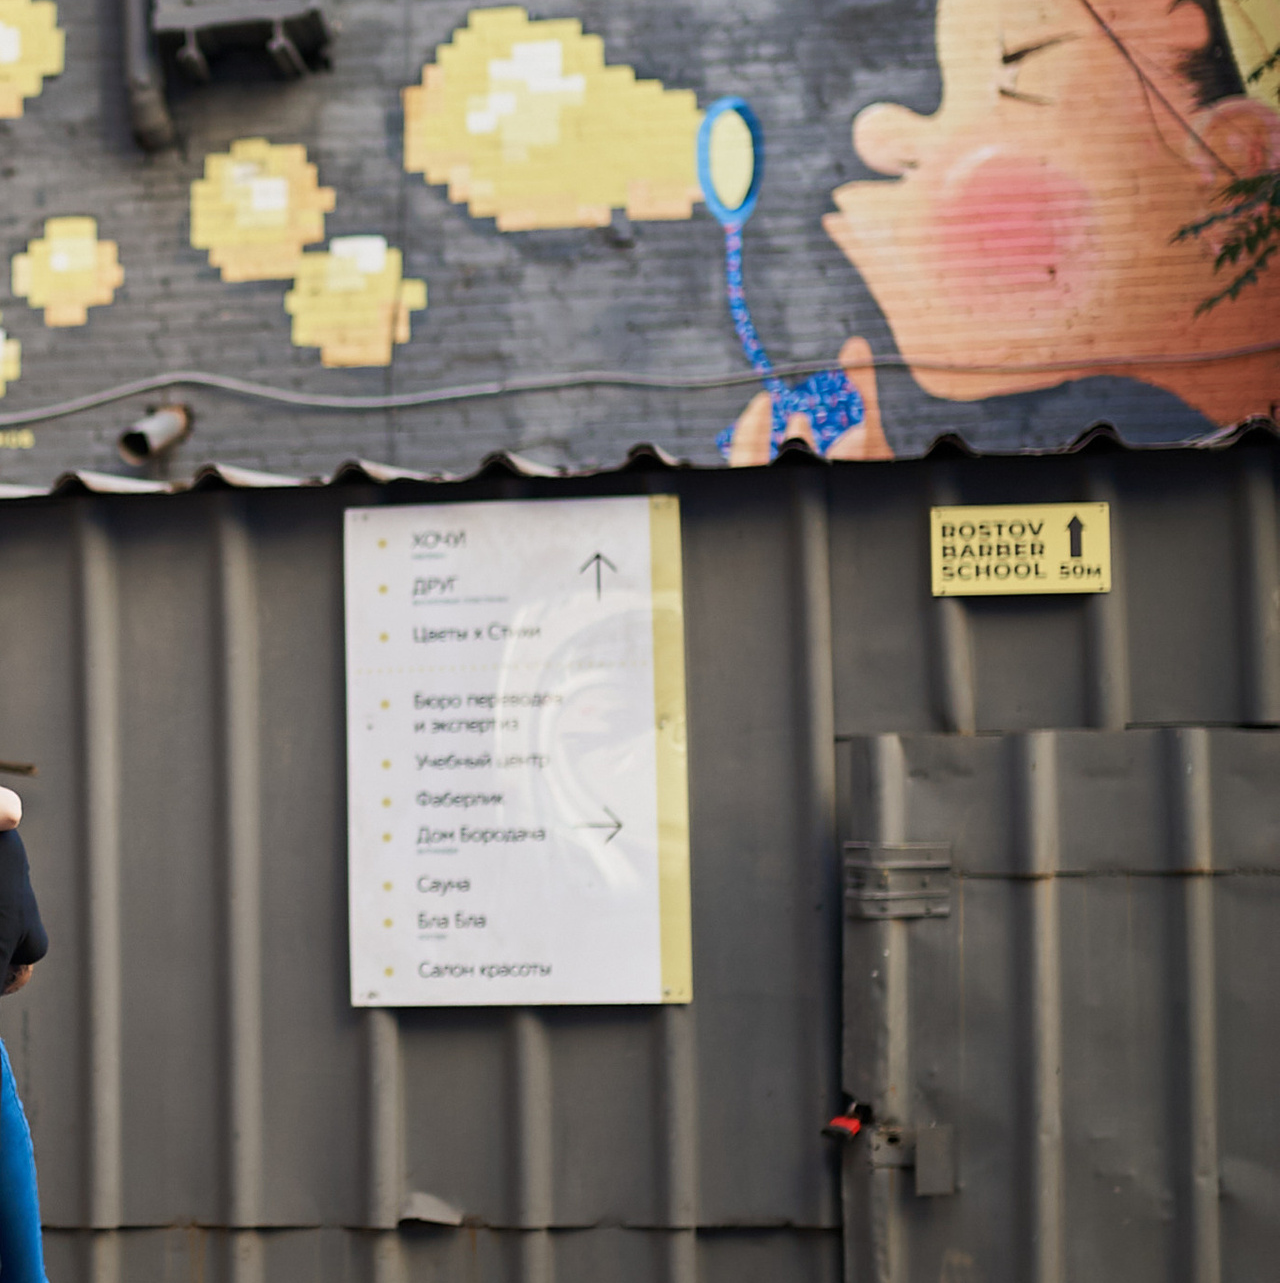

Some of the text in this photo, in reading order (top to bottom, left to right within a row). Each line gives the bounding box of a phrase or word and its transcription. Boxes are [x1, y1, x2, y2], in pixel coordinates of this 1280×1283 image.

[942, 522, 1044, 539] ROSTOV
[942, 543, 1045, 559] BARBER
[942, 563, 1047, 580] SCHOOL
[412, 626, 467, 643] Цветы
[414, 691, 462, 710] Бюро
[417, 825, 546, 845] Дом Бородача
[417, 875, 471, 896] Сауна
[418, 911, 487, 929] Бла Бла
[418, 961, 552, 979] Салон красоты
